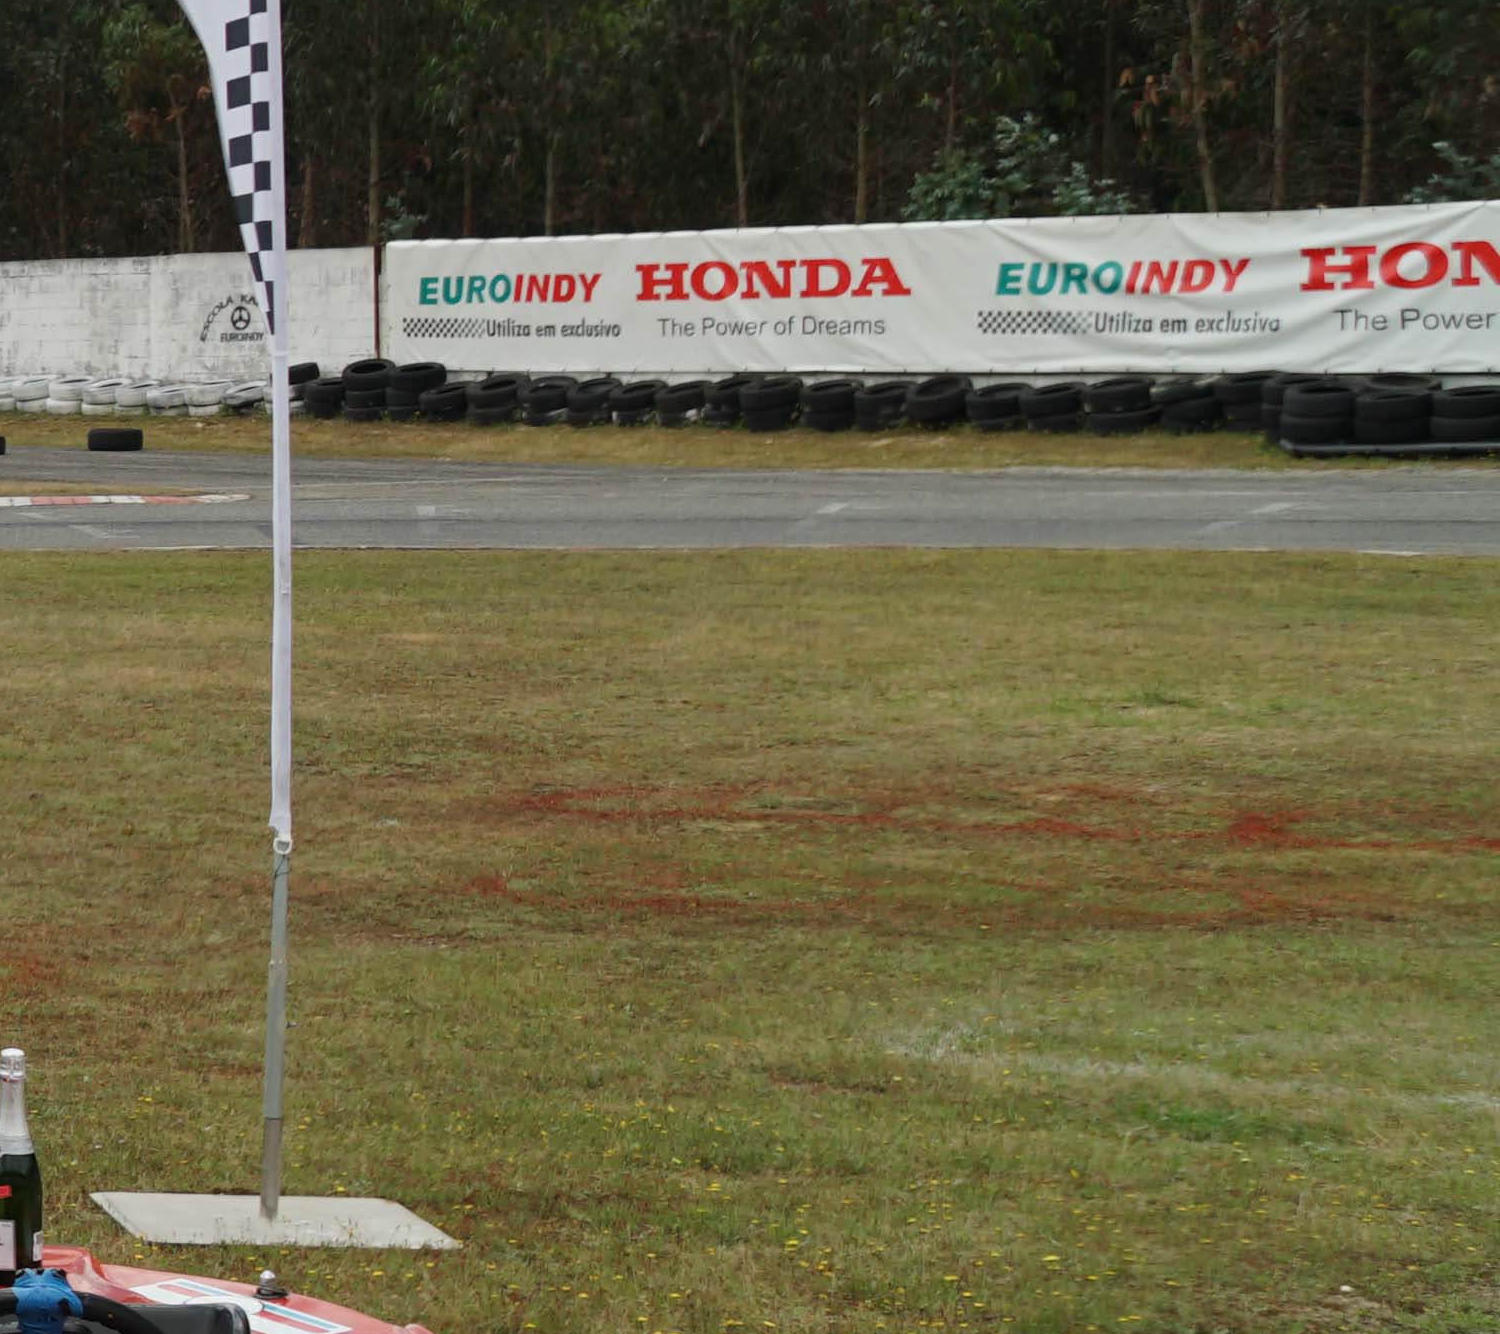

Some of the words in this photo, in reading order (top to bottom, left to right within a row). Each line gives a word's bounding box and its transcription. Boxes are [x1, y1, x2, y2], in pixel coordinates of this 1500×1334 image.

[418, 273, 602, 306] EUROINDY
[635, 257, 912, 302] HONDA
[995, 258, 1250, 297] EUROINDY
[486, 316, 531, 338] Utiliza
[535, 324, 557, 338] em
[560, 316, 621, 338] exclusivo
[657, 317, 696, 337] The
[702, 316, 767, 337] Power
[773, 315, 795, 335] of
[801, 315, 886, 336] Dreams
[1093, 310, 1154, 335] Utiliza
[1159, 318, 1188, 334] em
[1193, 312, 1282, 335] exclusivo
[1334, 308, 1389, 333] The
[1400, 307, 1497, 331] Power
